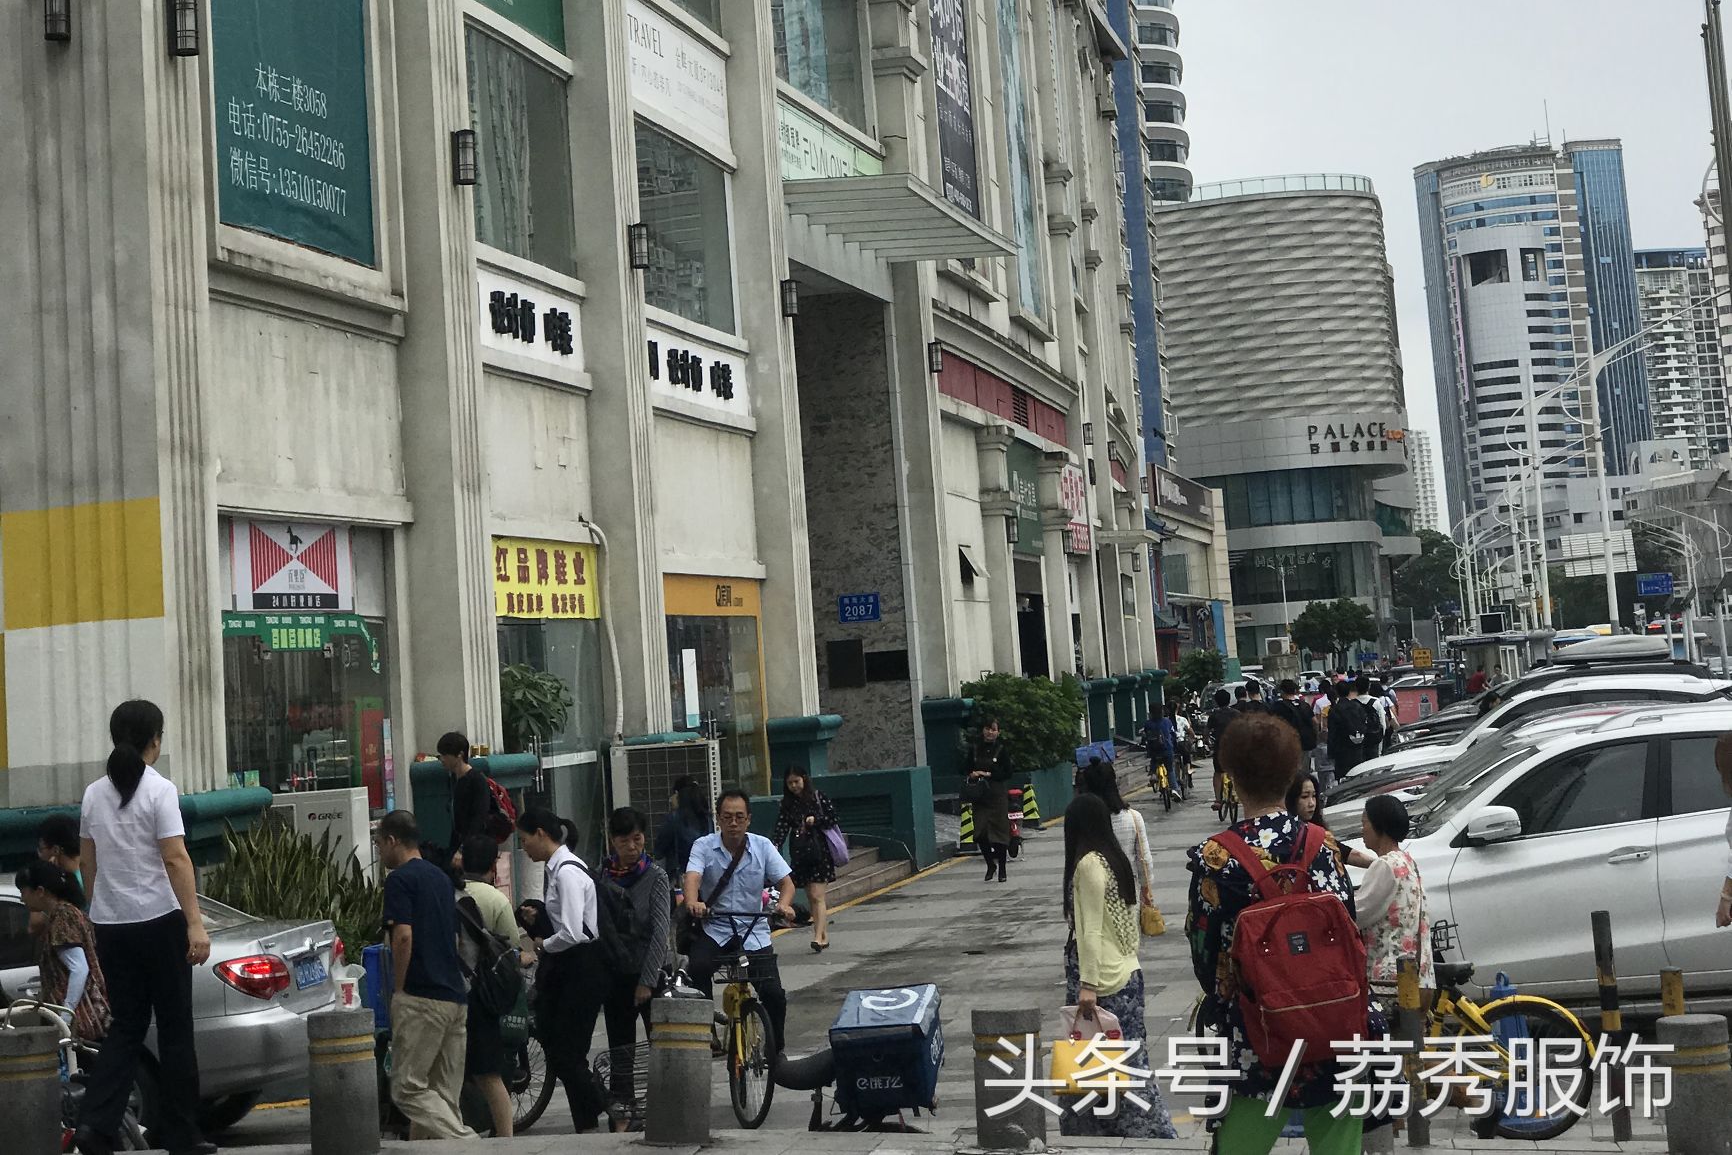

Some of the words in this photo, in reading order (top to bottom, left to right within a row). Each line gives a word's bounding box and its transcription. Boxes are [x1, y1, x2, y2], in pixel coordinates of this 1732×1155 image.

[627, 14, 664, 59] TRAVEL
[1308, 422, 1386, 440] PALACE
[845, 605, 873, 617] 2087
